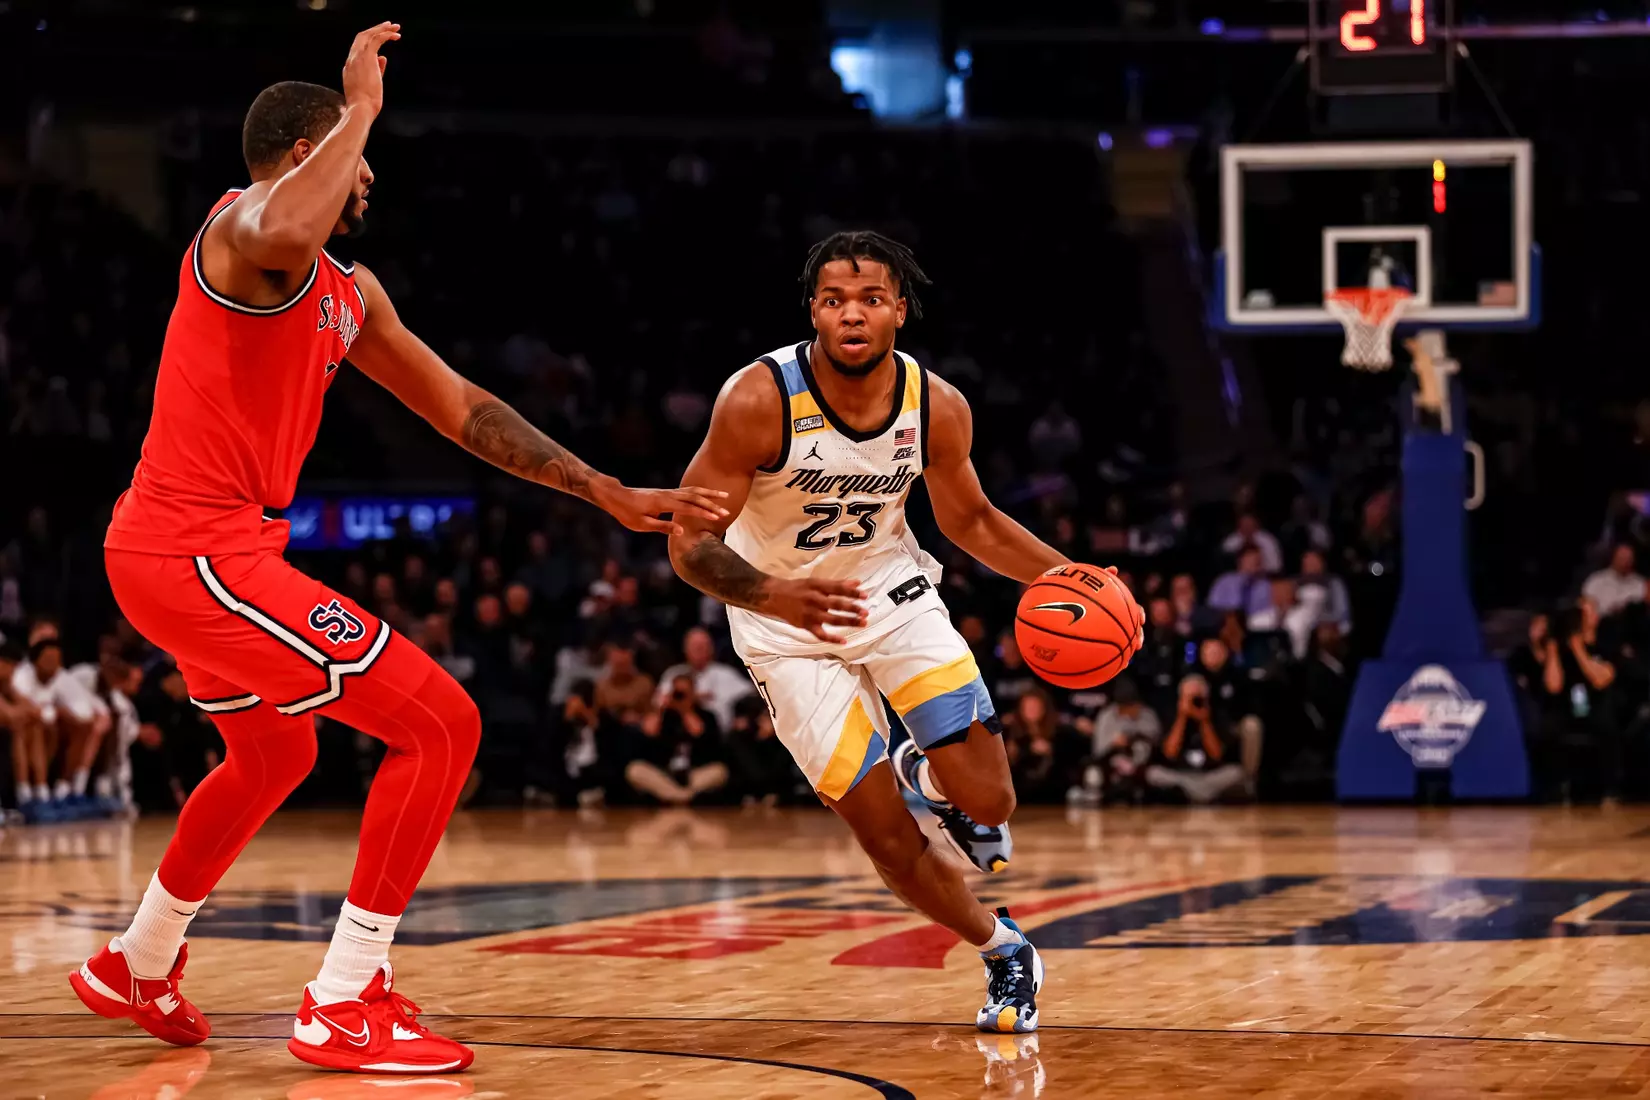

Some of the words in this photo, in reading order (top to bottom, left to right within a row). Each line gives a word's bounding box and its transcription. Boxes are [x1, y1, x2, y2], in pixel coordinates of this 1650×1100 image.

[785, 464, 916, 498] Marquette
[794, 502, 886, 550] 23
[1044, 566, 1105, 593] ELITE
